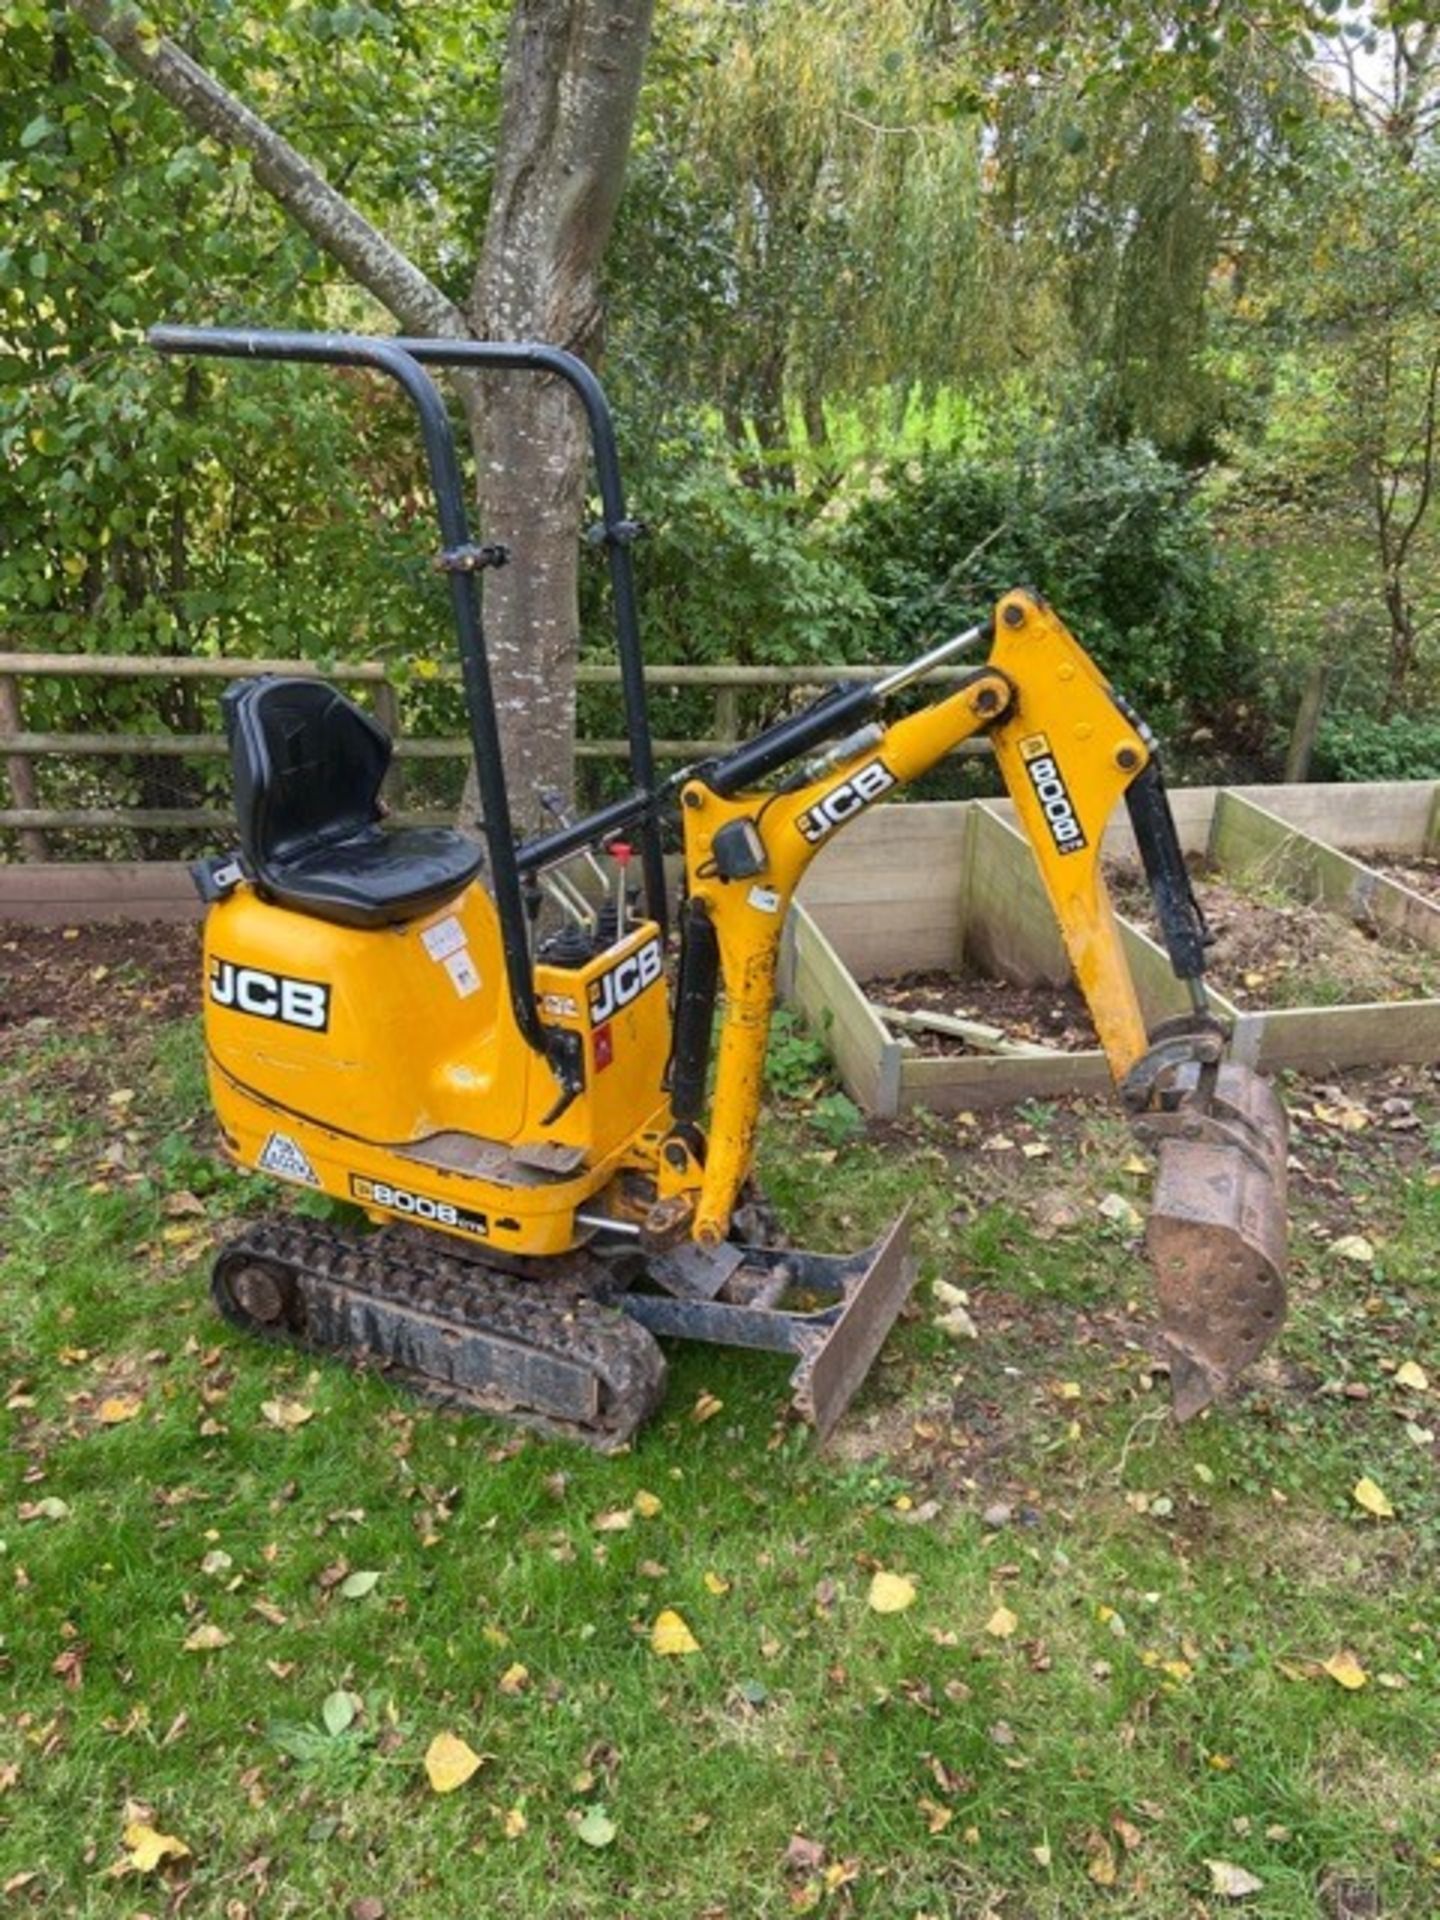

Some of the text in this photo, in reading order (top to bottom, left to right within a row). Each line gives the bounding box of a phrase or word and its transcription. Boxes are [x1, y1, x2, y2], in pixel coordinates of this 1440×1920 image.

[806, 762, 894, 841] JCB
[1029, 757, 1081, 841] 8008
[210, 962, 326, 1028] JCB
[591, 939, 661, 1023] JCB
[374, 1183, 457, 1226] 8008
